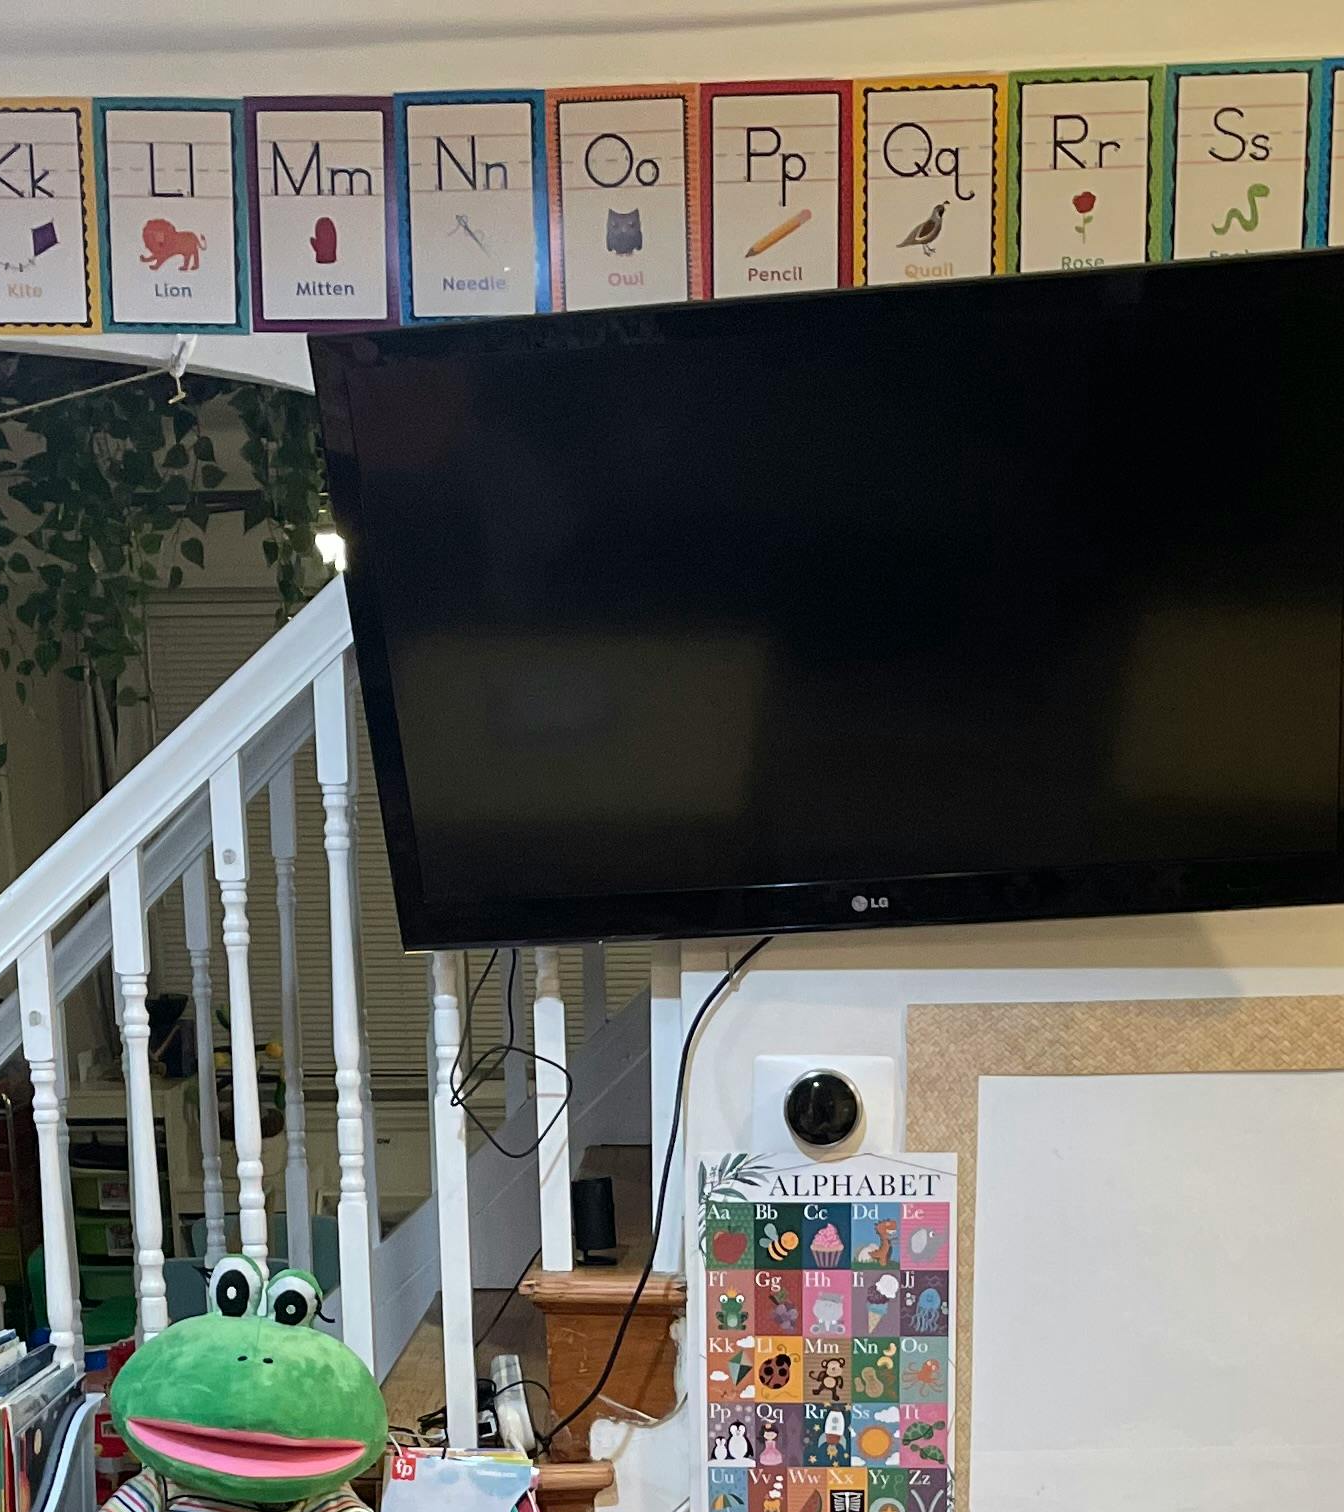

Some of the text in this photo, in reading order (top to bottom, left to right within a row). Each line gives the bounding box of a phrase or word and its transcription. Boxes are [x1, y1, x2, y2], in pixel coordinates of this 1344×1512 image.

[1054, 114, 1122, 170] Rr
[1209, 108, 1270, 164] Ss
[271, 140, 372, 197] Mm
[435, 135, 507, 193] Nn
[746, 127, 806, 207] Pp
[883, 122, 975, 202] Qq
[747, 266, 803, 283] Pencil
[155, 281, 192, 300] Lion
[296, 279, 354, 298] Mitten
[870, 896, 889, 908] LG
[769, 1175, 941, 1197] ALPHABET
[707, 1204, 731, 1220] Aa
[755, 1271, 782, 1292] Gg
[805, 1404, 827, 1419] Rr
[908, 1470, 931, 1485] Zz
